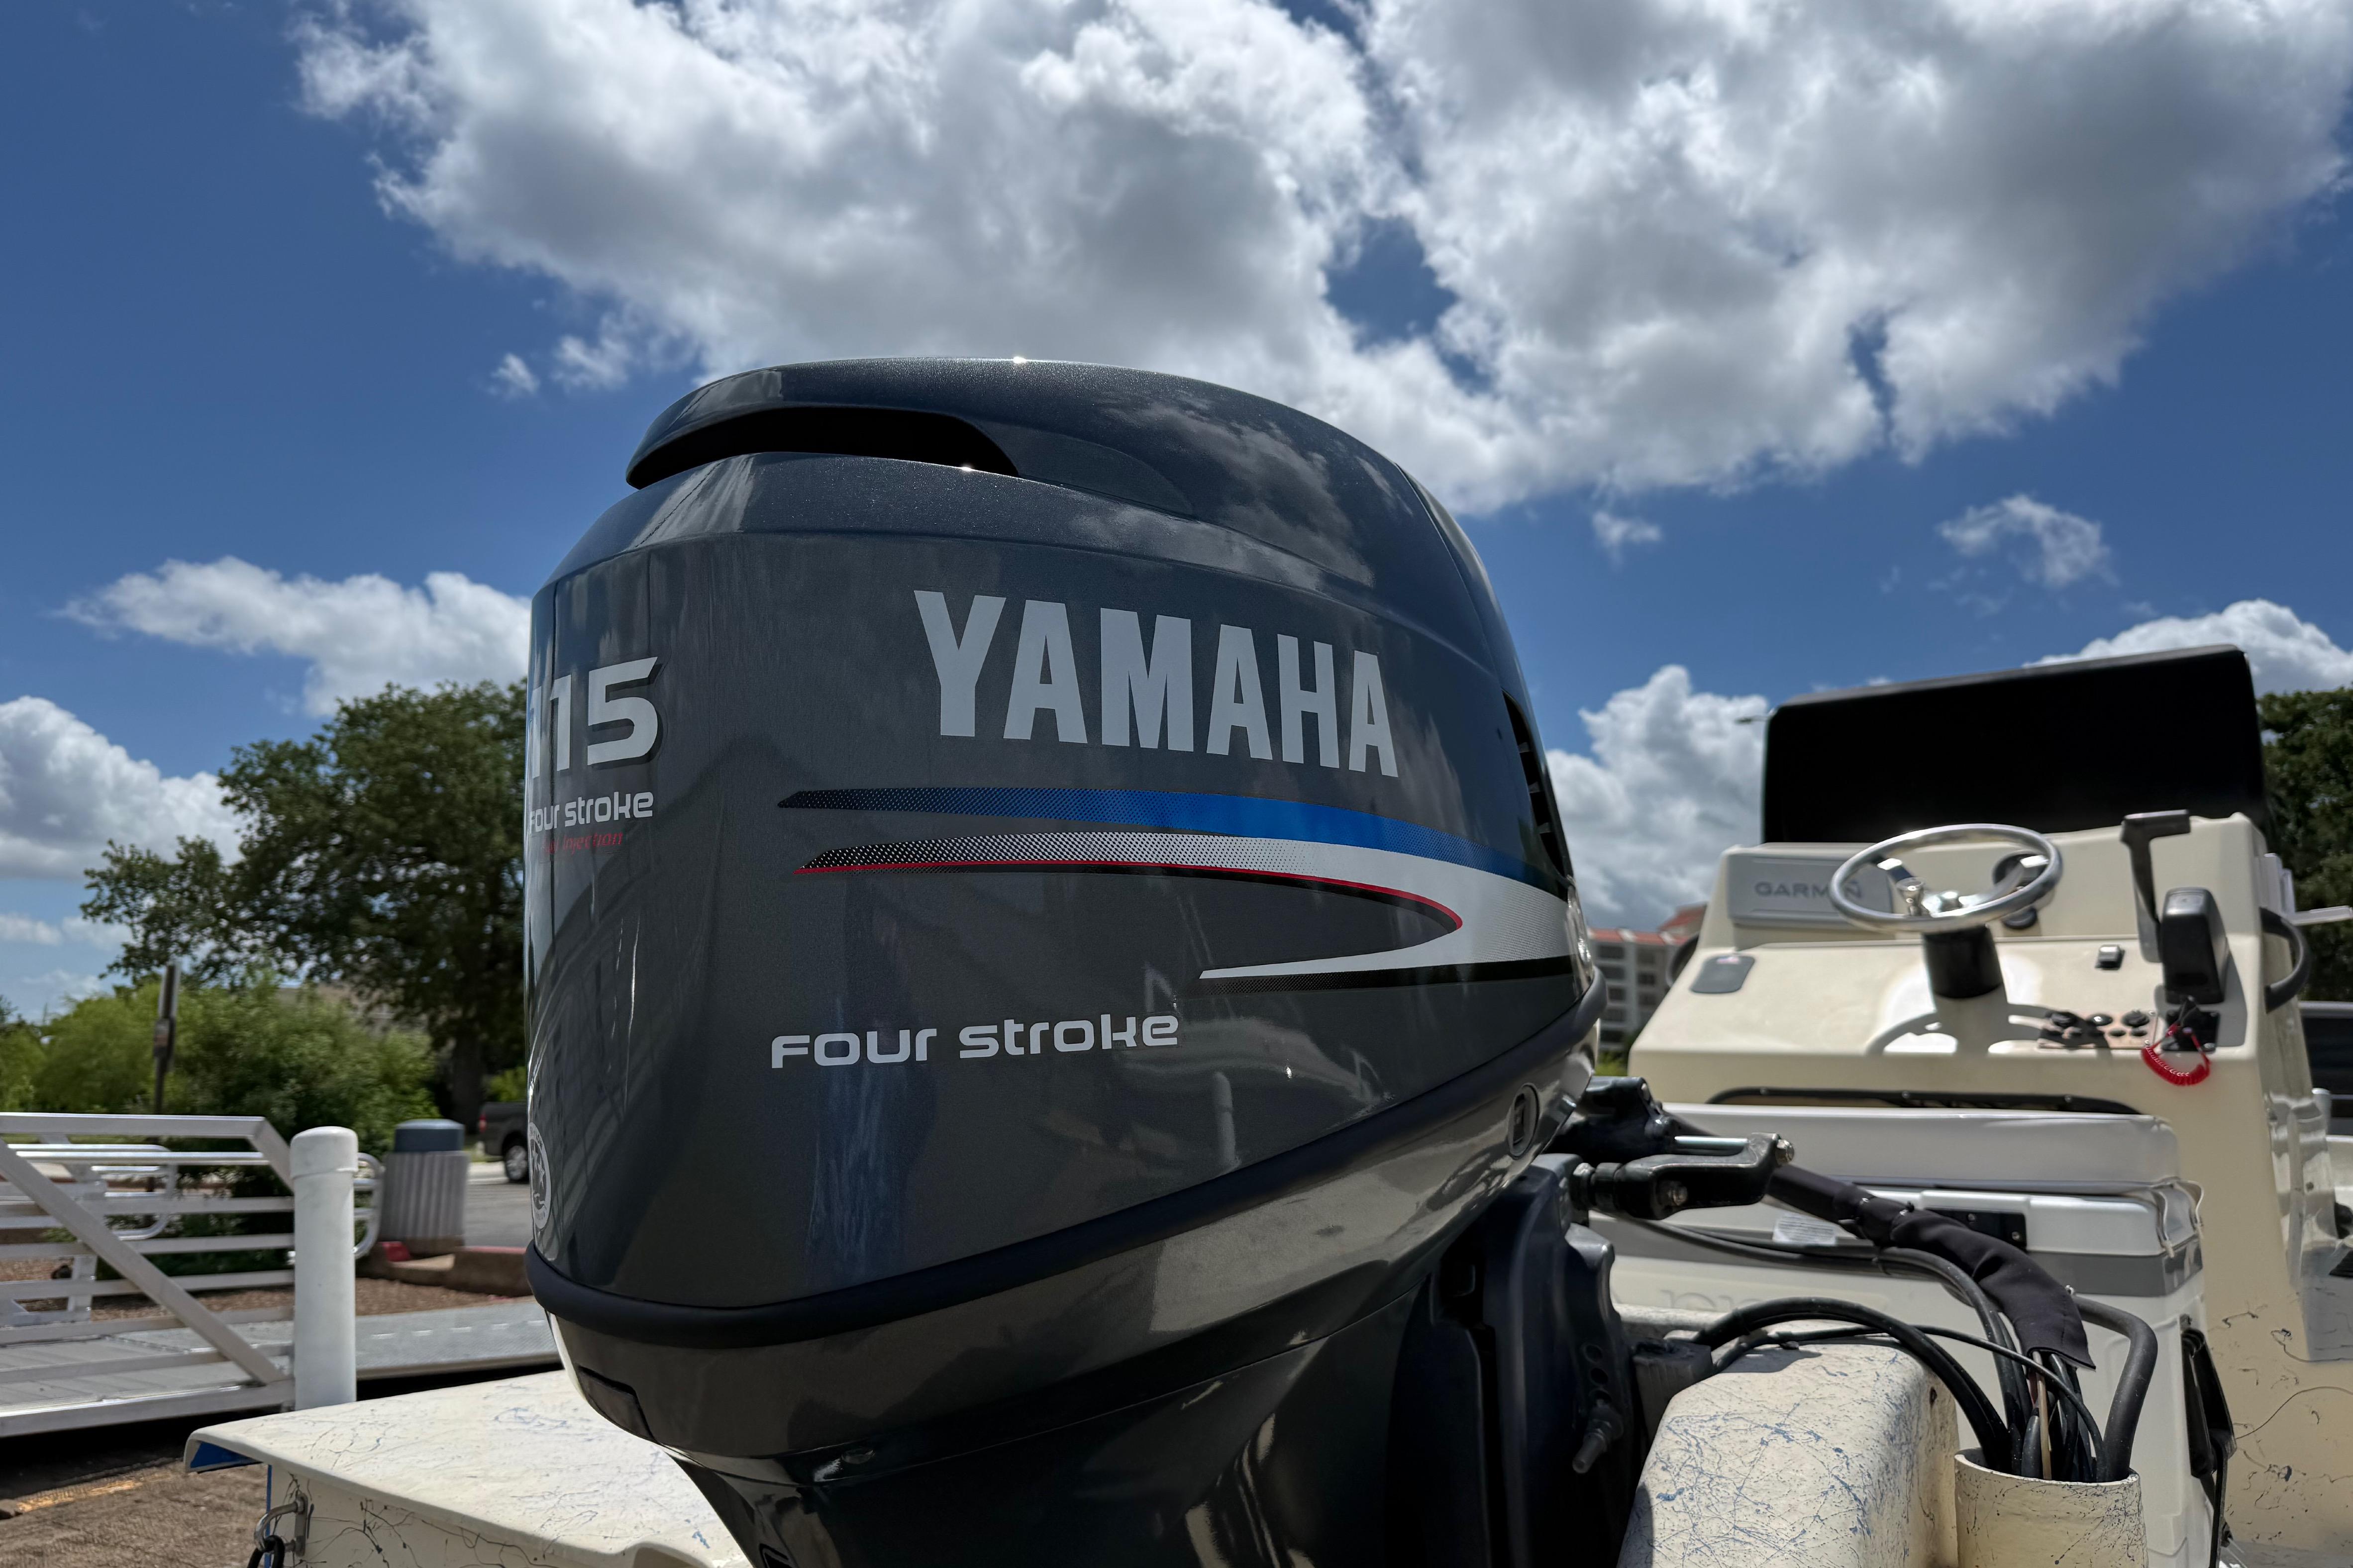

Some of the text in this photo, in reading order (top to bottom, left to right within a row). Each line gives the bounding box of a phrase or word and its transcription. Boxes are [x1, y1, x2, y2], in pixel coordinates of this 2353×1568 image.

[529, 656, 662, 779] 115
[913, 590, 1399, 778] YAMAHA
[564, 791, 654, 827] stroke
[771, 1014, 1179, 1069] Four stroke
